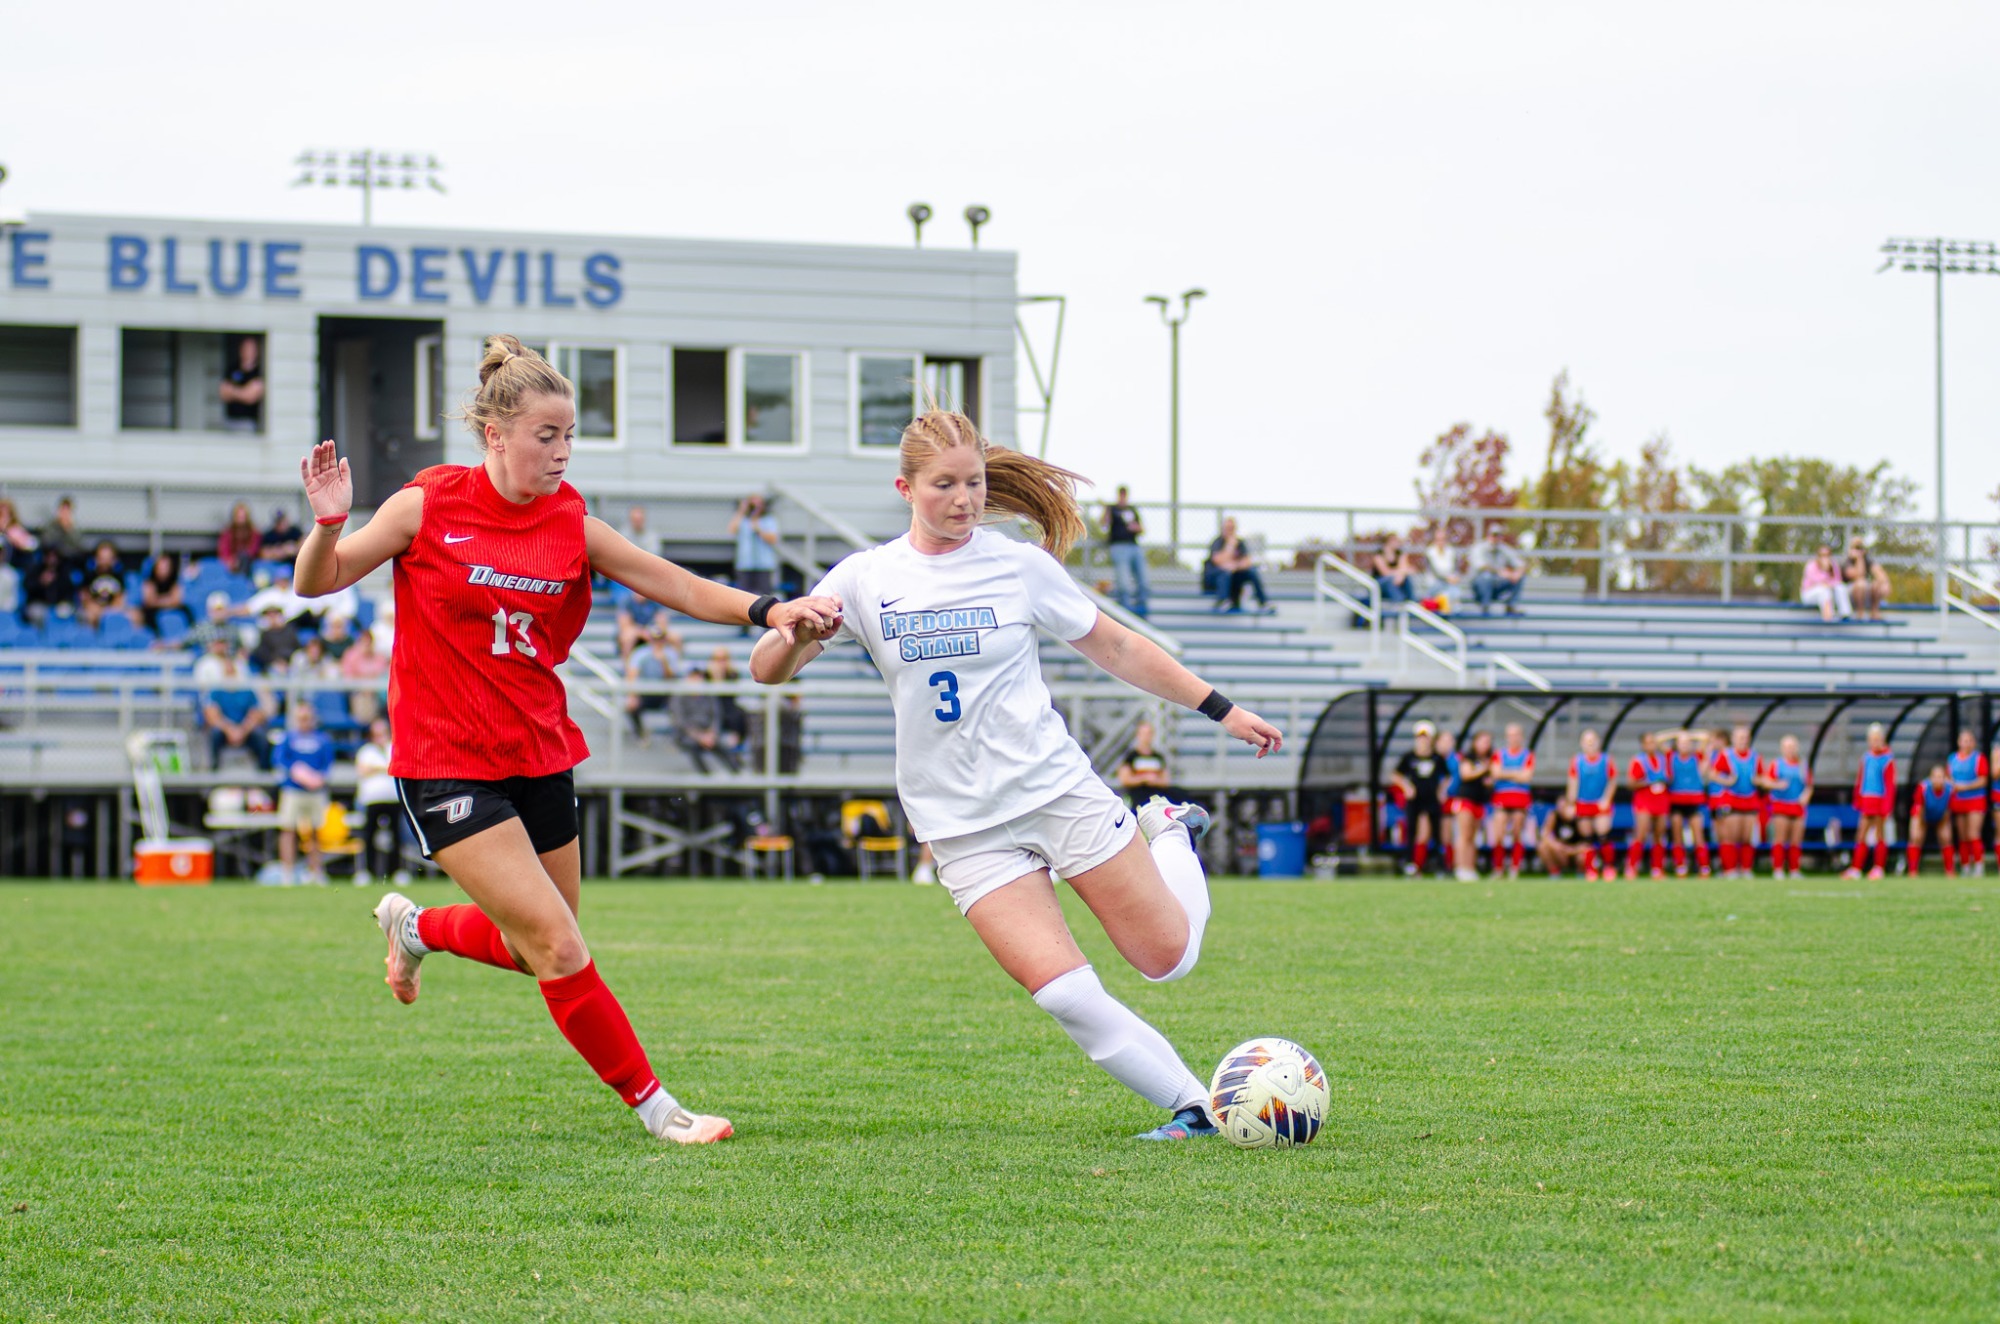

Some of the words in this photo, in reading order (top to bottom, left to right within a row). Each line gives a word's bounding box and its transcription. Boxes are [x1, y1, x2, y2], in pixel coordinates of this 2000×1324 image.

[0, 230, 51, 288] E
[109, 235, 303, 298] BLUE
[357, 245, 624, 309] DEVILS
[492, 607, 537, 657] 13
[880, 607, 998, 640] FREDONIA
[900, 631, 980, 662] STATE
[929, 671, 961, 722] 3
